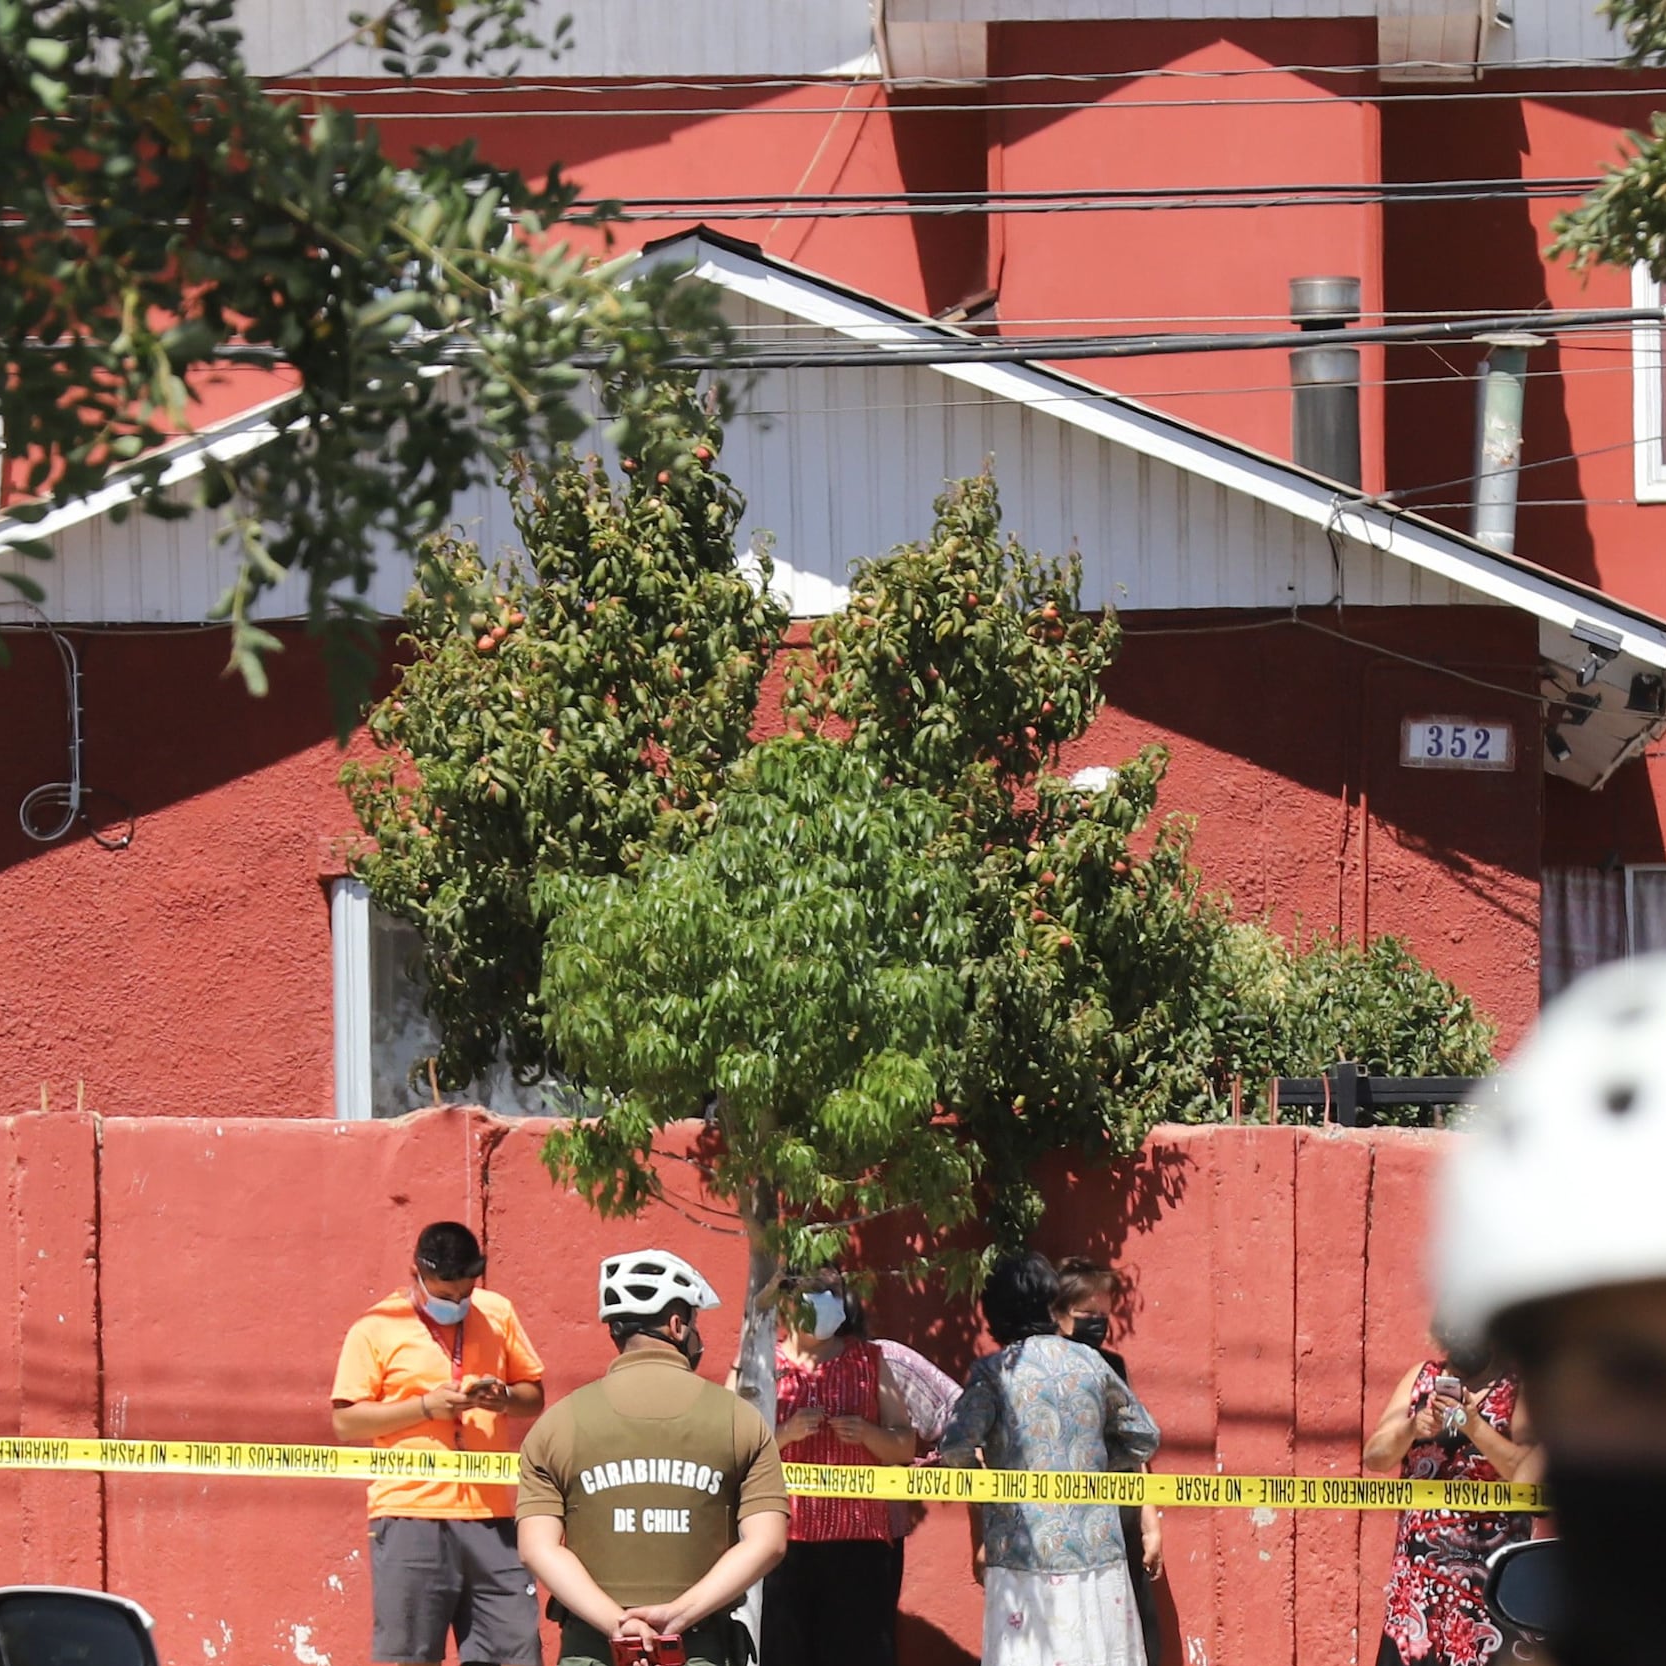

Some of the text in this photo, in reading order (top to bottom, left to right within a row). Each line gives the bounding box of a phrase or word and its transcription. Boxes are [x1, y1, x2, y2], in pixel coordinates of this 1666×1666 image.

[1427, 725, 1490, 760] 352
[100, 1441, 144, 1466] PASAR
[150, 1443, 167, 1467] NO
[185, 1444, 221, 1468] CHILE
[226, 1445, 241, 1469] DE
[248, 1446, 338, 1473] CARABINEROS
[370, 1450, 414, 1475] PASAR
[419, 1452, 436, 1475] NO
[454, 1454, 490, 1478] CHILE
[496, 1455, 510, 1479] DE
[580, 1458, 724, 1495] CARABINEROS
[786, 1465, 875, 1494] CARABINEROS
[907, 1469, 951, 1496] PASAR
[957, 1471, 973, 1497] NO
[991, 1472, 1027, 1498] CHILE
[1031, 1473, 1048, 1499] DE
[1055, 1474, 1145, 1501] CARABINEROS
[1176, 1476, 1220, 1502] PASAR
[1226, 1478, 1242, 1503] NO
[1259, 1478, 1295, 1503] CHILE
[1300, 1480, 1316, 1504] DE
[1323, 1480, 1413, 1505] CARABINEROS
[1444, 1482, 1489, 1506] PASAR
[1494, 1483, 1511, 1506] NO
[613, 1508, 691, 1533] DE CHILE
